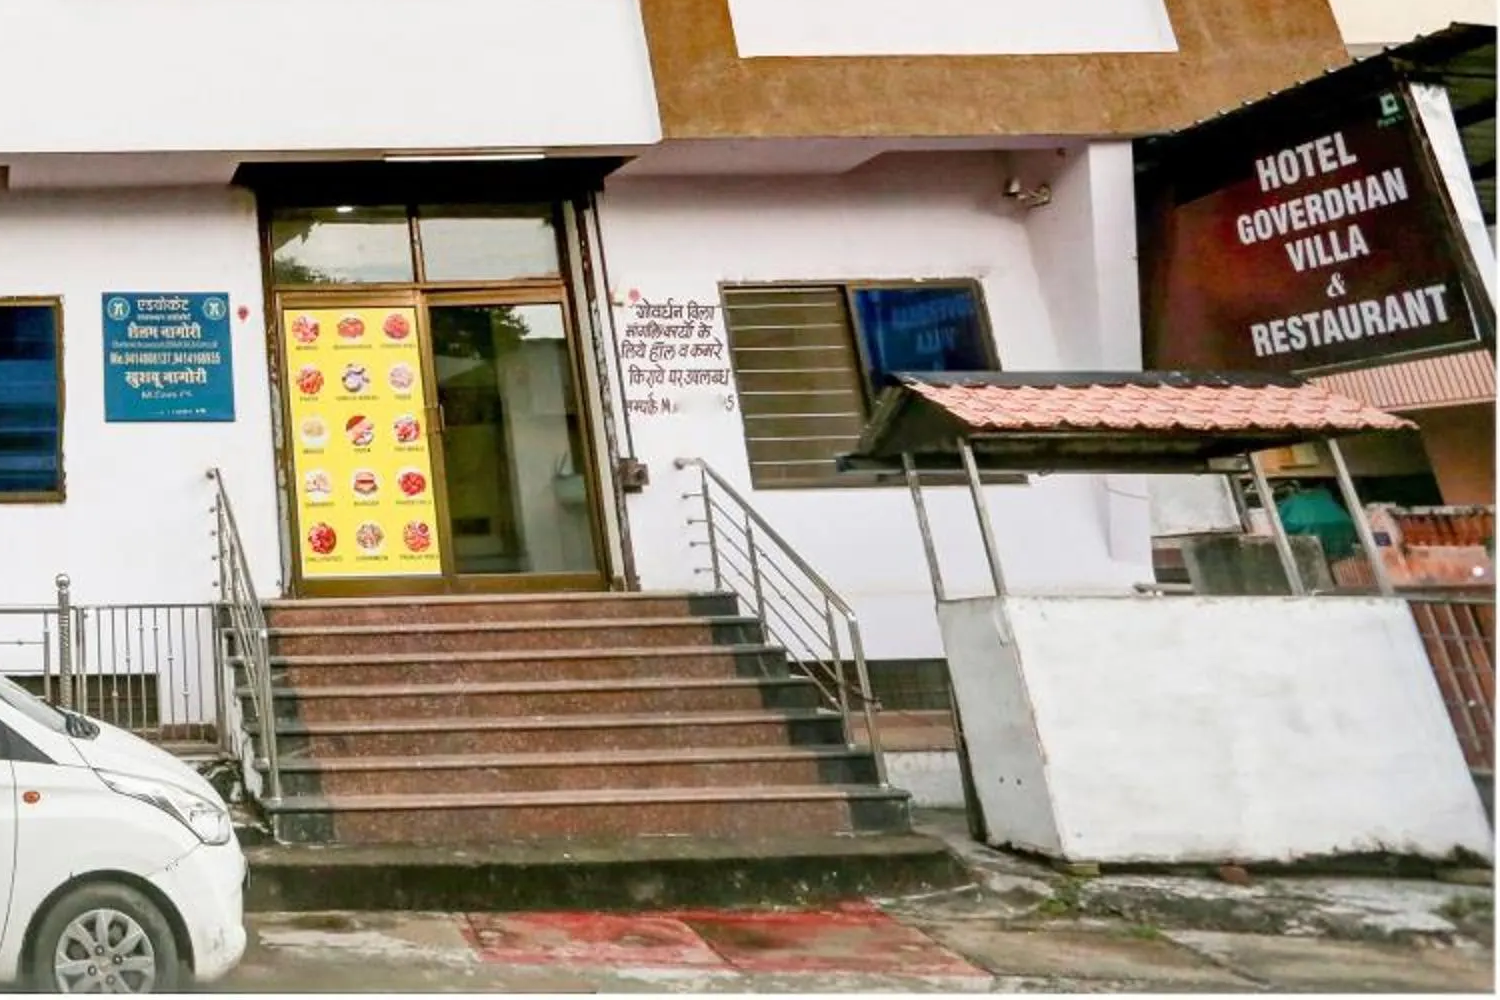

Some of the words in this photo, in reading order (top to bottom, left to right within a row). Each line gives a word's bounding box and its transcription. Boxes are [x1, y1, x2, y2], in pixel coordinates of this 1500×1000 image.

[1255, 131, 1358, 193] HOTEL
[1236, 167, 1409, 245] GOVERDHAN
[1285, 224, 1369, 272] VILLA
[1326, 272, 1347, 298] &
[1251, 284, 1449, 357] RESTAURANT
